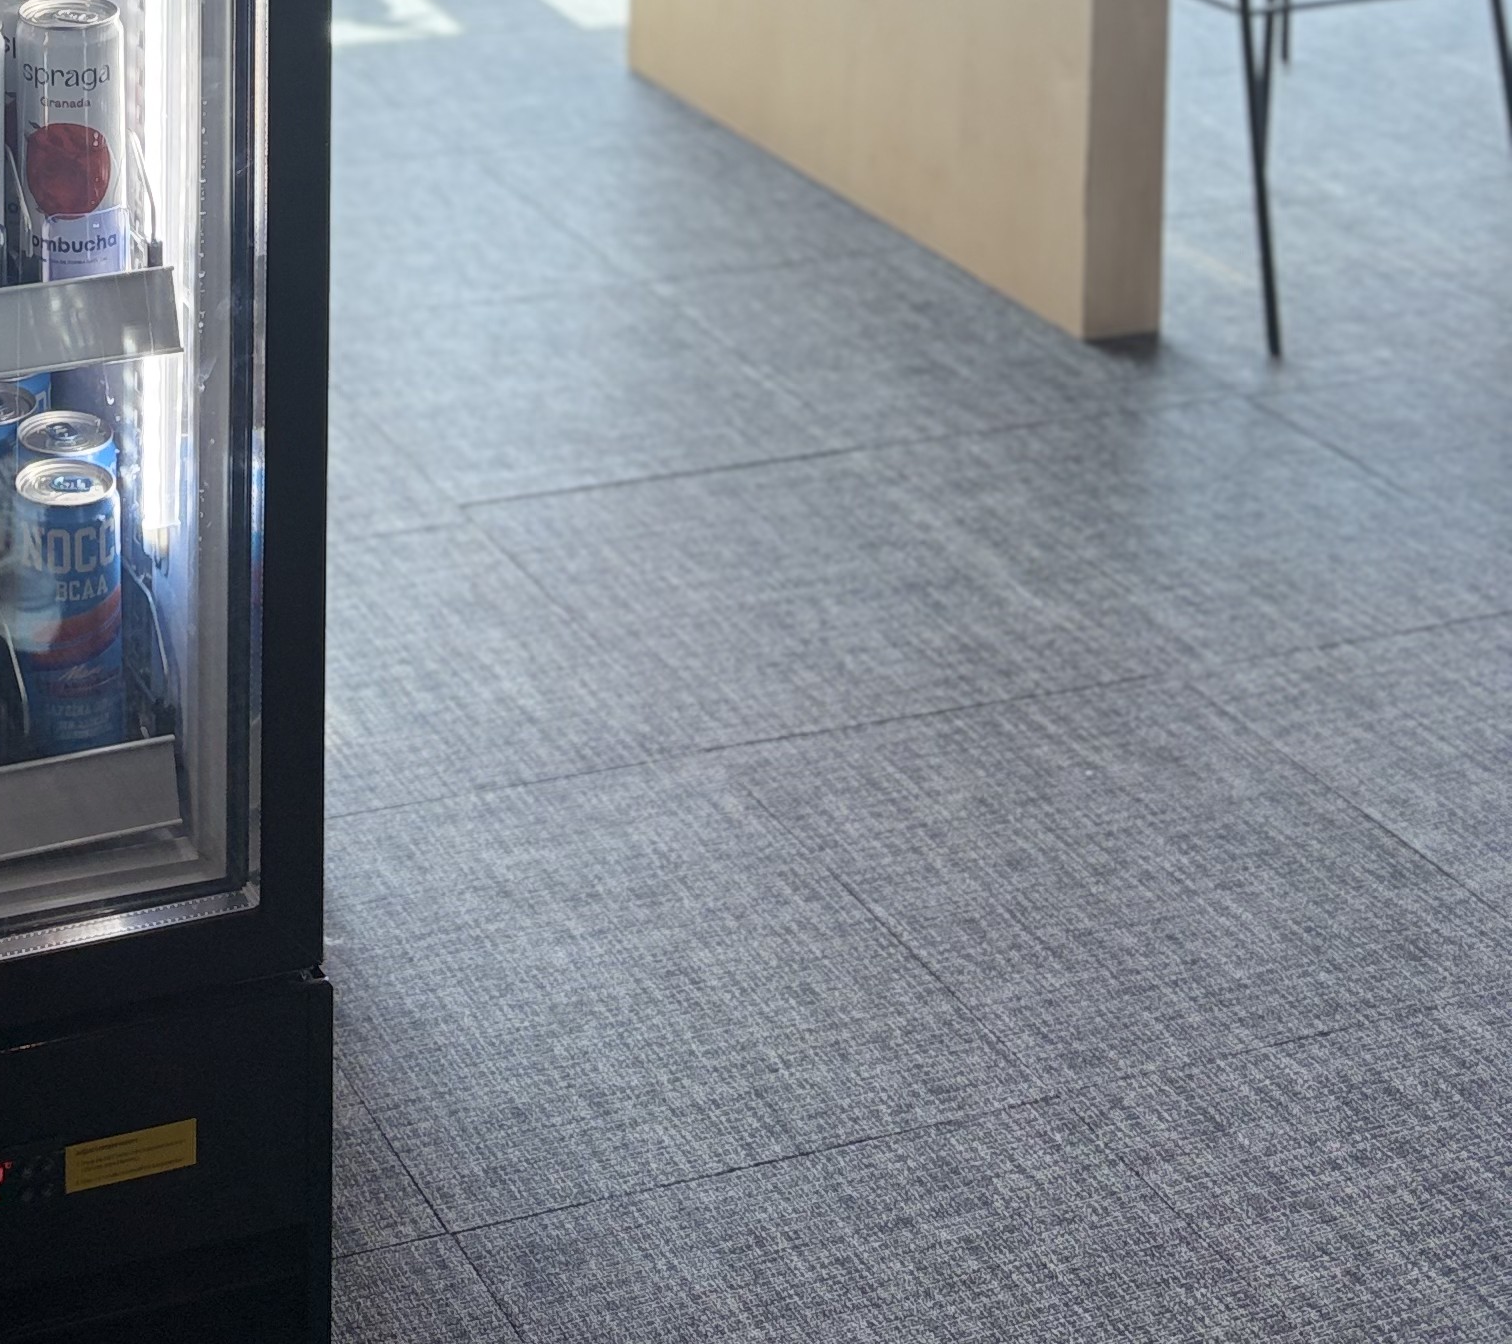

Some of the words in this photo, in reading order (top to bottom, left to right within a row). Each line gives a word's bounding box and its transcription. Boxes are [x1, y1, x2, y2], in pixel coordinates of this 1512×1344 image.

[23, 63, 111, 91] spraga
[40, 96, 91, 109] Granada
[55, 574, 108, 603] BCAA
